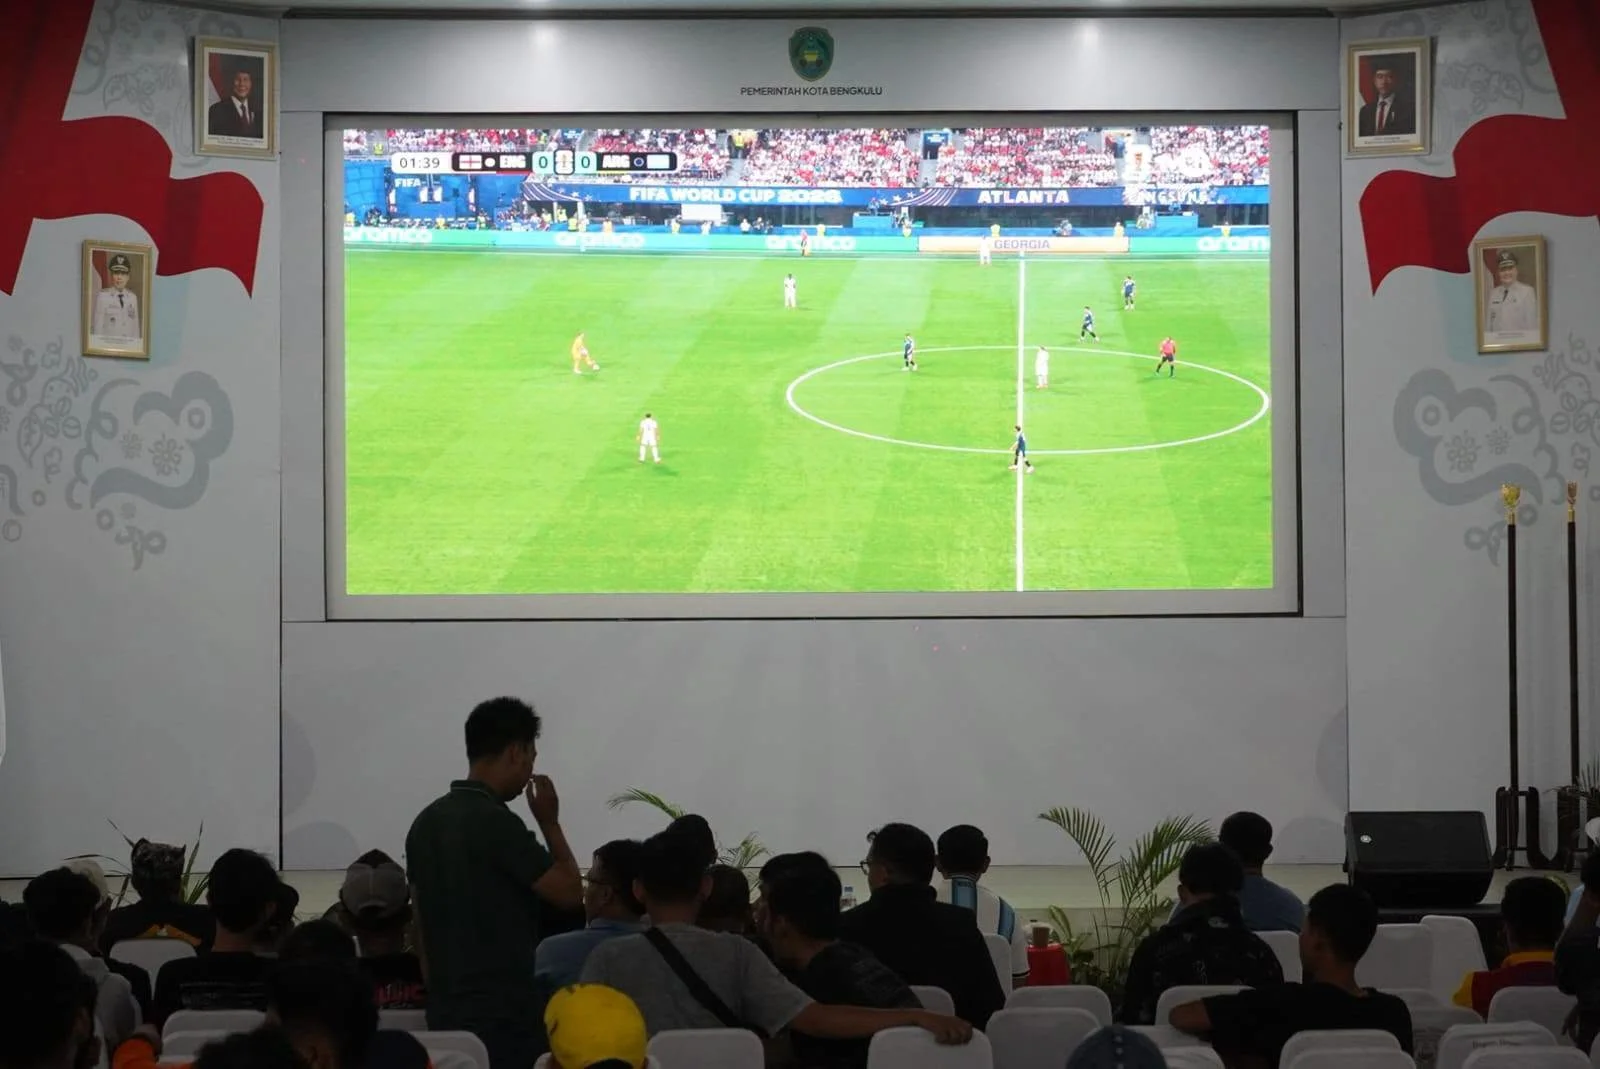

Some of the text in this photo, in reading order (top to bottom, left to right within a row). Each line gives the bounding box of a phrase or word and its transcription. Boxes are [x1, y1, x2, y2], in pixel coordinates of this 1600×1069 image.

[740, 87, 883, 96] PEMERINTAH KOTA BENGKULU
[399, 157, 441, 169] 01:39
[538, 156, 548, 169] 0
[581, 156, 590, 169] 0
[602, 155, 630, 168] ARG
[394, 178, 421, 188] FIFA
[629, 187, 843, 204] FIFA WORLD CUP 2026
[977, 189, 1070, 204] ATLANTA
[993, 239, 1051, 250] GEORGIA
